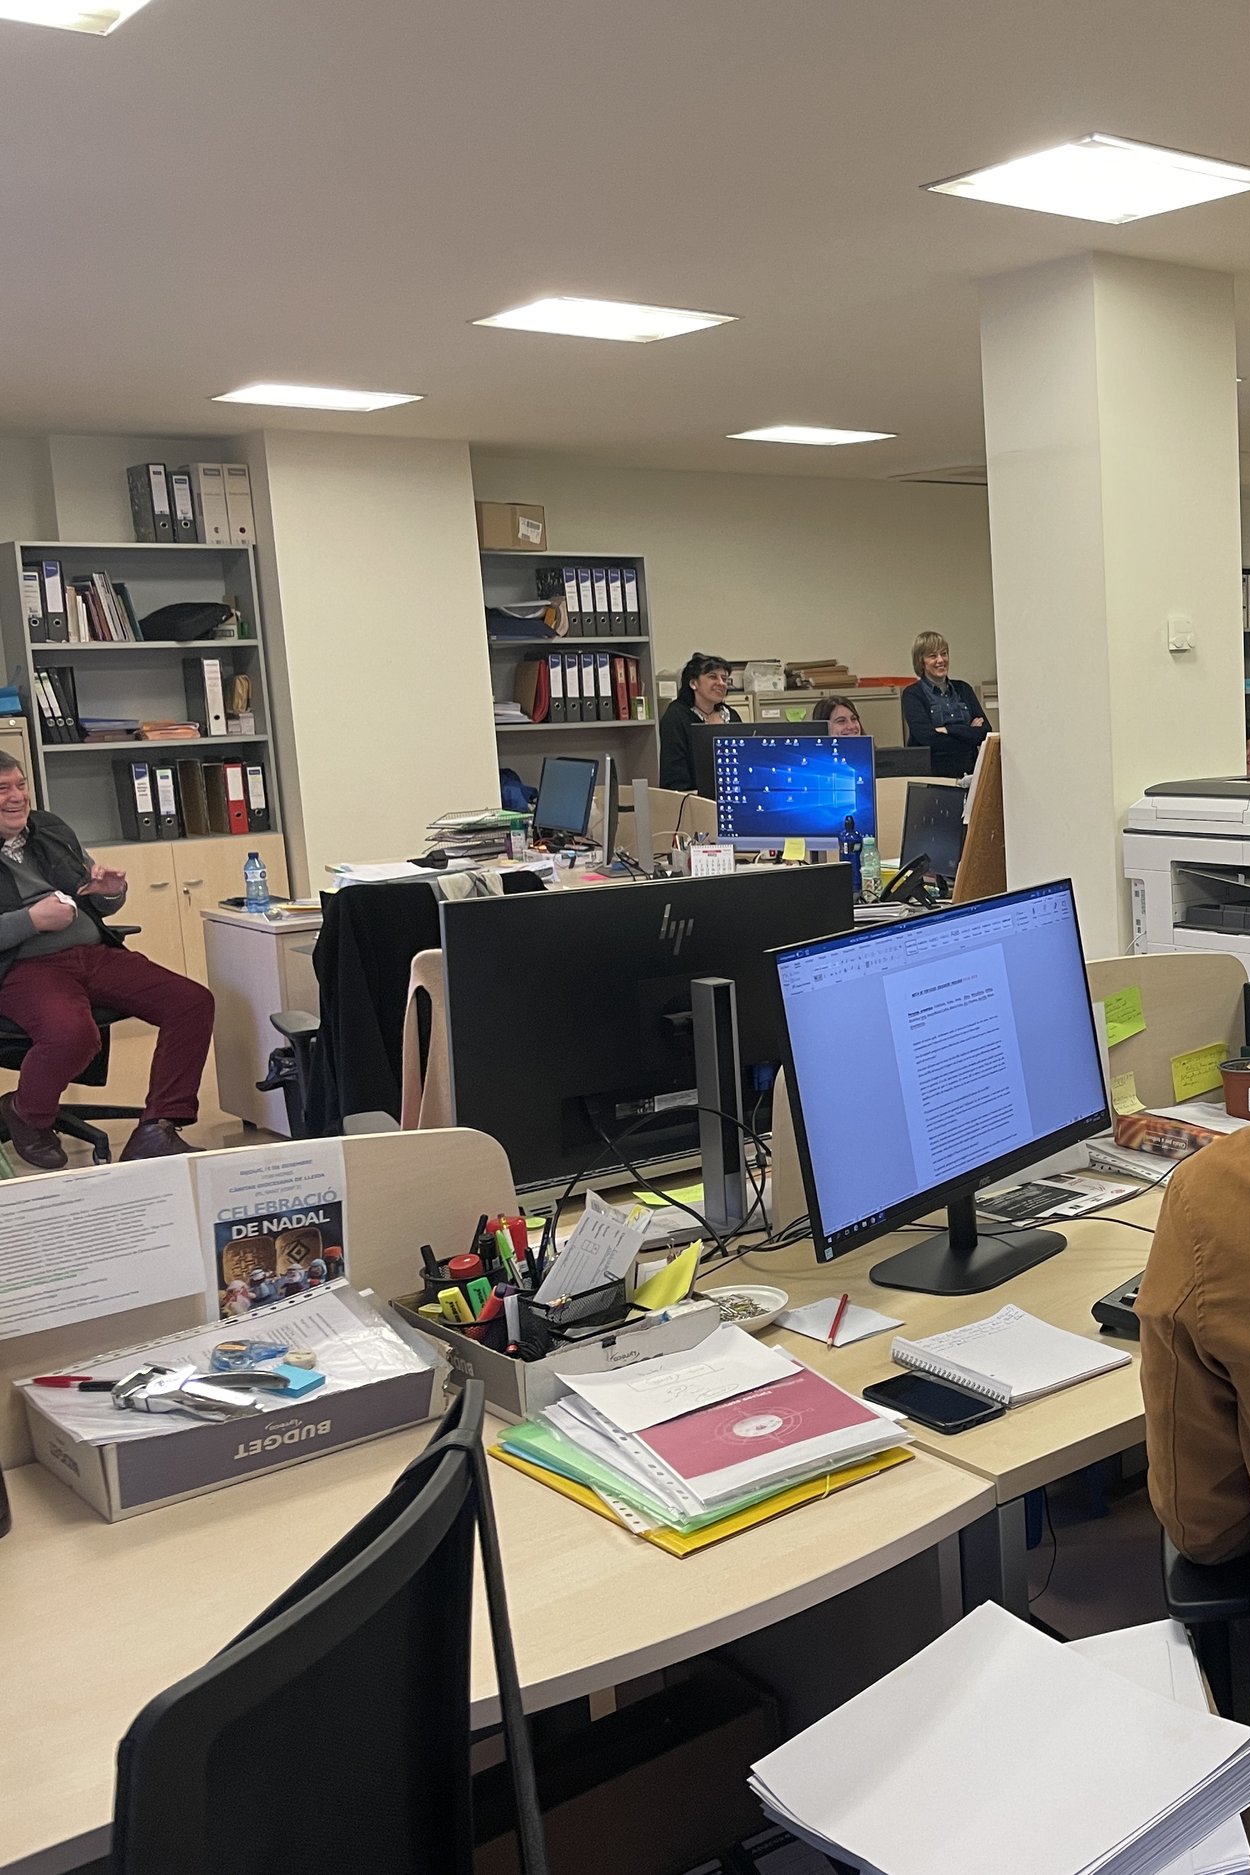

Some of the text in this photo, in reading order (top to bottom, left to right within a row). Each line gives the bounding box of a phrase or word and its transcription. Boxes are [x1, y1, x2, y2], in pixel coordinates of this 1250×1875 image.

[217, 1187, 337, 1221] CELEBRACIÓ
[231, 1210, 331, 1240] DE NADAL
[234, 1419, 331, 1460] BUDGET
